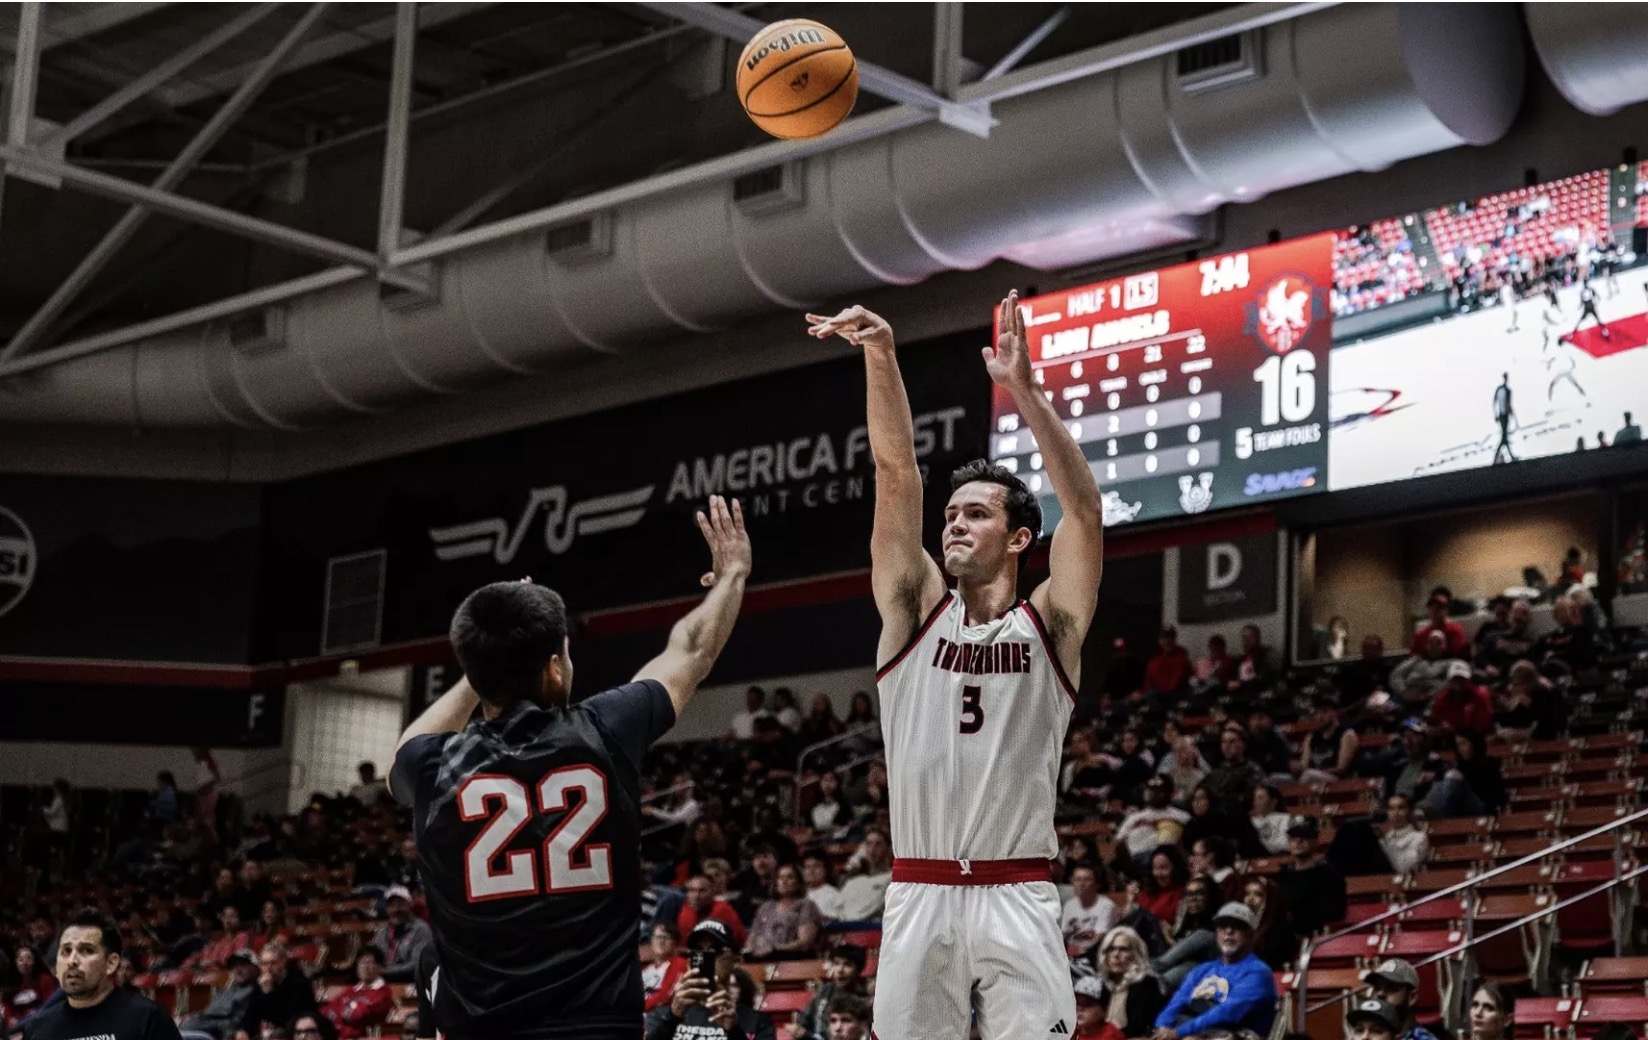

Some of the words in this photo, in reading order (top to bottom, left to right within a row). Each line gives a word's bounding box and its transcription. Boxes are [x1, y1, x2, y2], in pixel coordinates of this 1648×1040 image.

[746, 30, 825, 70] Wilson
[1199, 253, 1250, 296] 7:44
[1067, 287, 1105, 318] HALF
[1109, 284, 1121, 309] 1
[1254, 349, 1316, 425] 16
[664, 431, 838, 504] AMERICA
[842, 405, 966, 471] FST
[1236, 427, 1253, 459] 5
[1253, 429, 1284, 451] TEAM
[1284, 422, 1321, 446] FOULS
[1207, 541, 1243, 590] D
[247, 692, 266, 730] F
[959, 684, 984, 734] 3
[457, 763, 612, 903] 22
